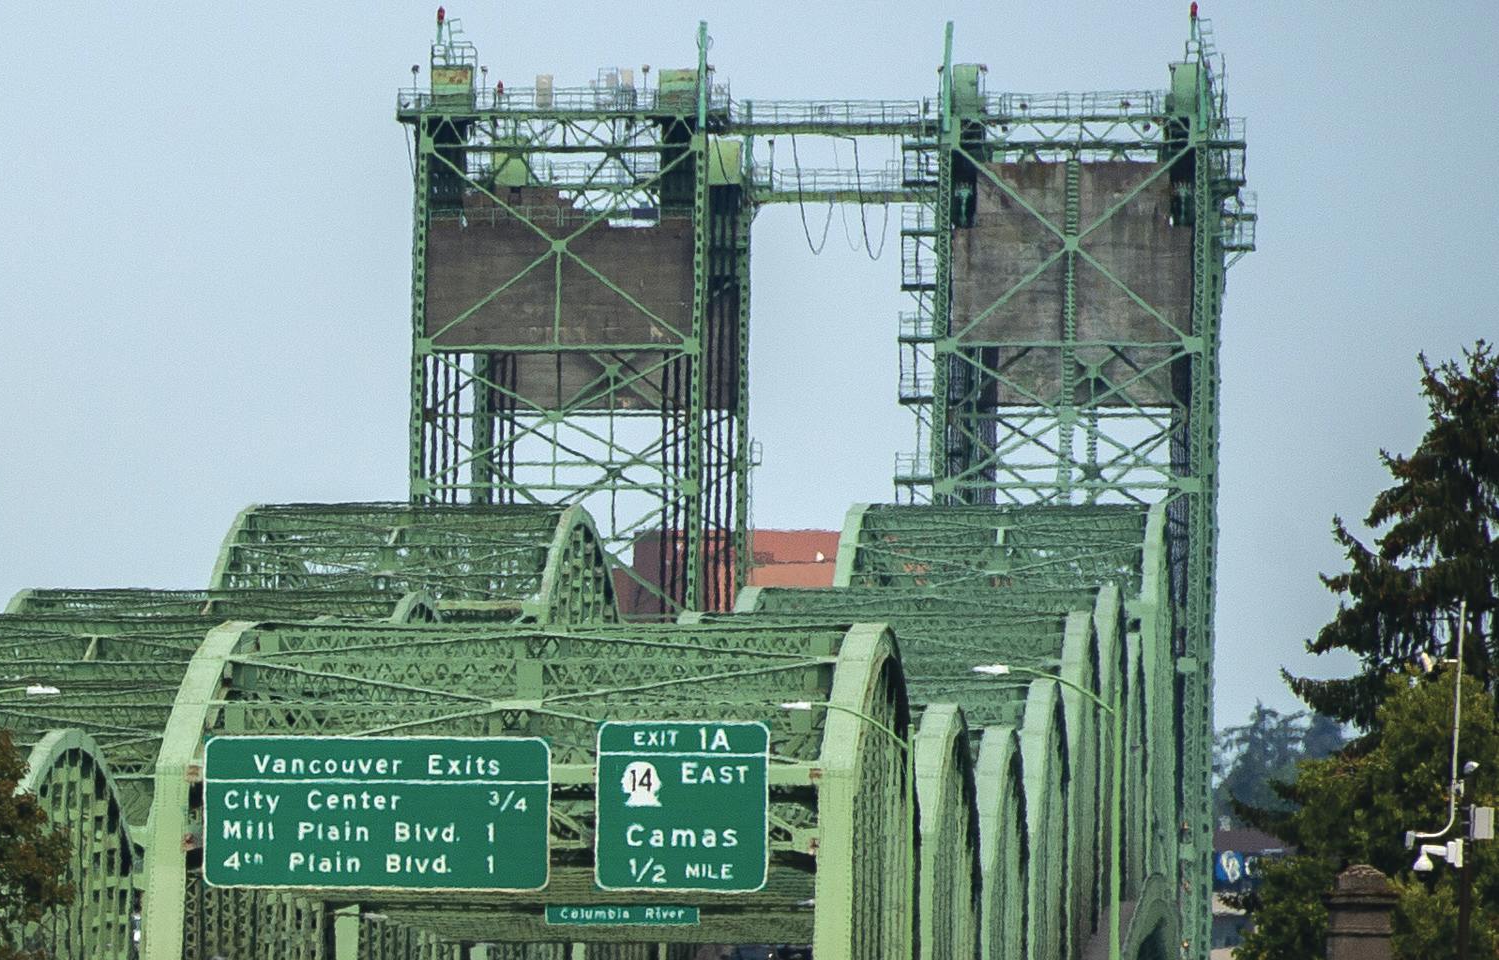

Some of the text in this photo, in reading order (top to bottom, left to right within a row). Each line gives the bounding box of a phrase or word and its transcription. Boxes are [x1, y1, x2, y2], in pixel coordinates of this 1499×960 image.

[633, 727, 731, 751] EXIT 1A
[253, 754, 500, 775] Vancouver Exits
[630, 762, 749, 792] 14 EAST
[224, 790, 527, 814] City Center 3/4
[223, 820, 495, 842] Mill Plain Blvd. 1
[626, 823, 739, 848] Camas
[223, 852, 494, 873] 4th Plain Blvd. 1
[629, 858, 734, 883] 1/2 MILE
[560, 908, 685, 920] Columbia River
